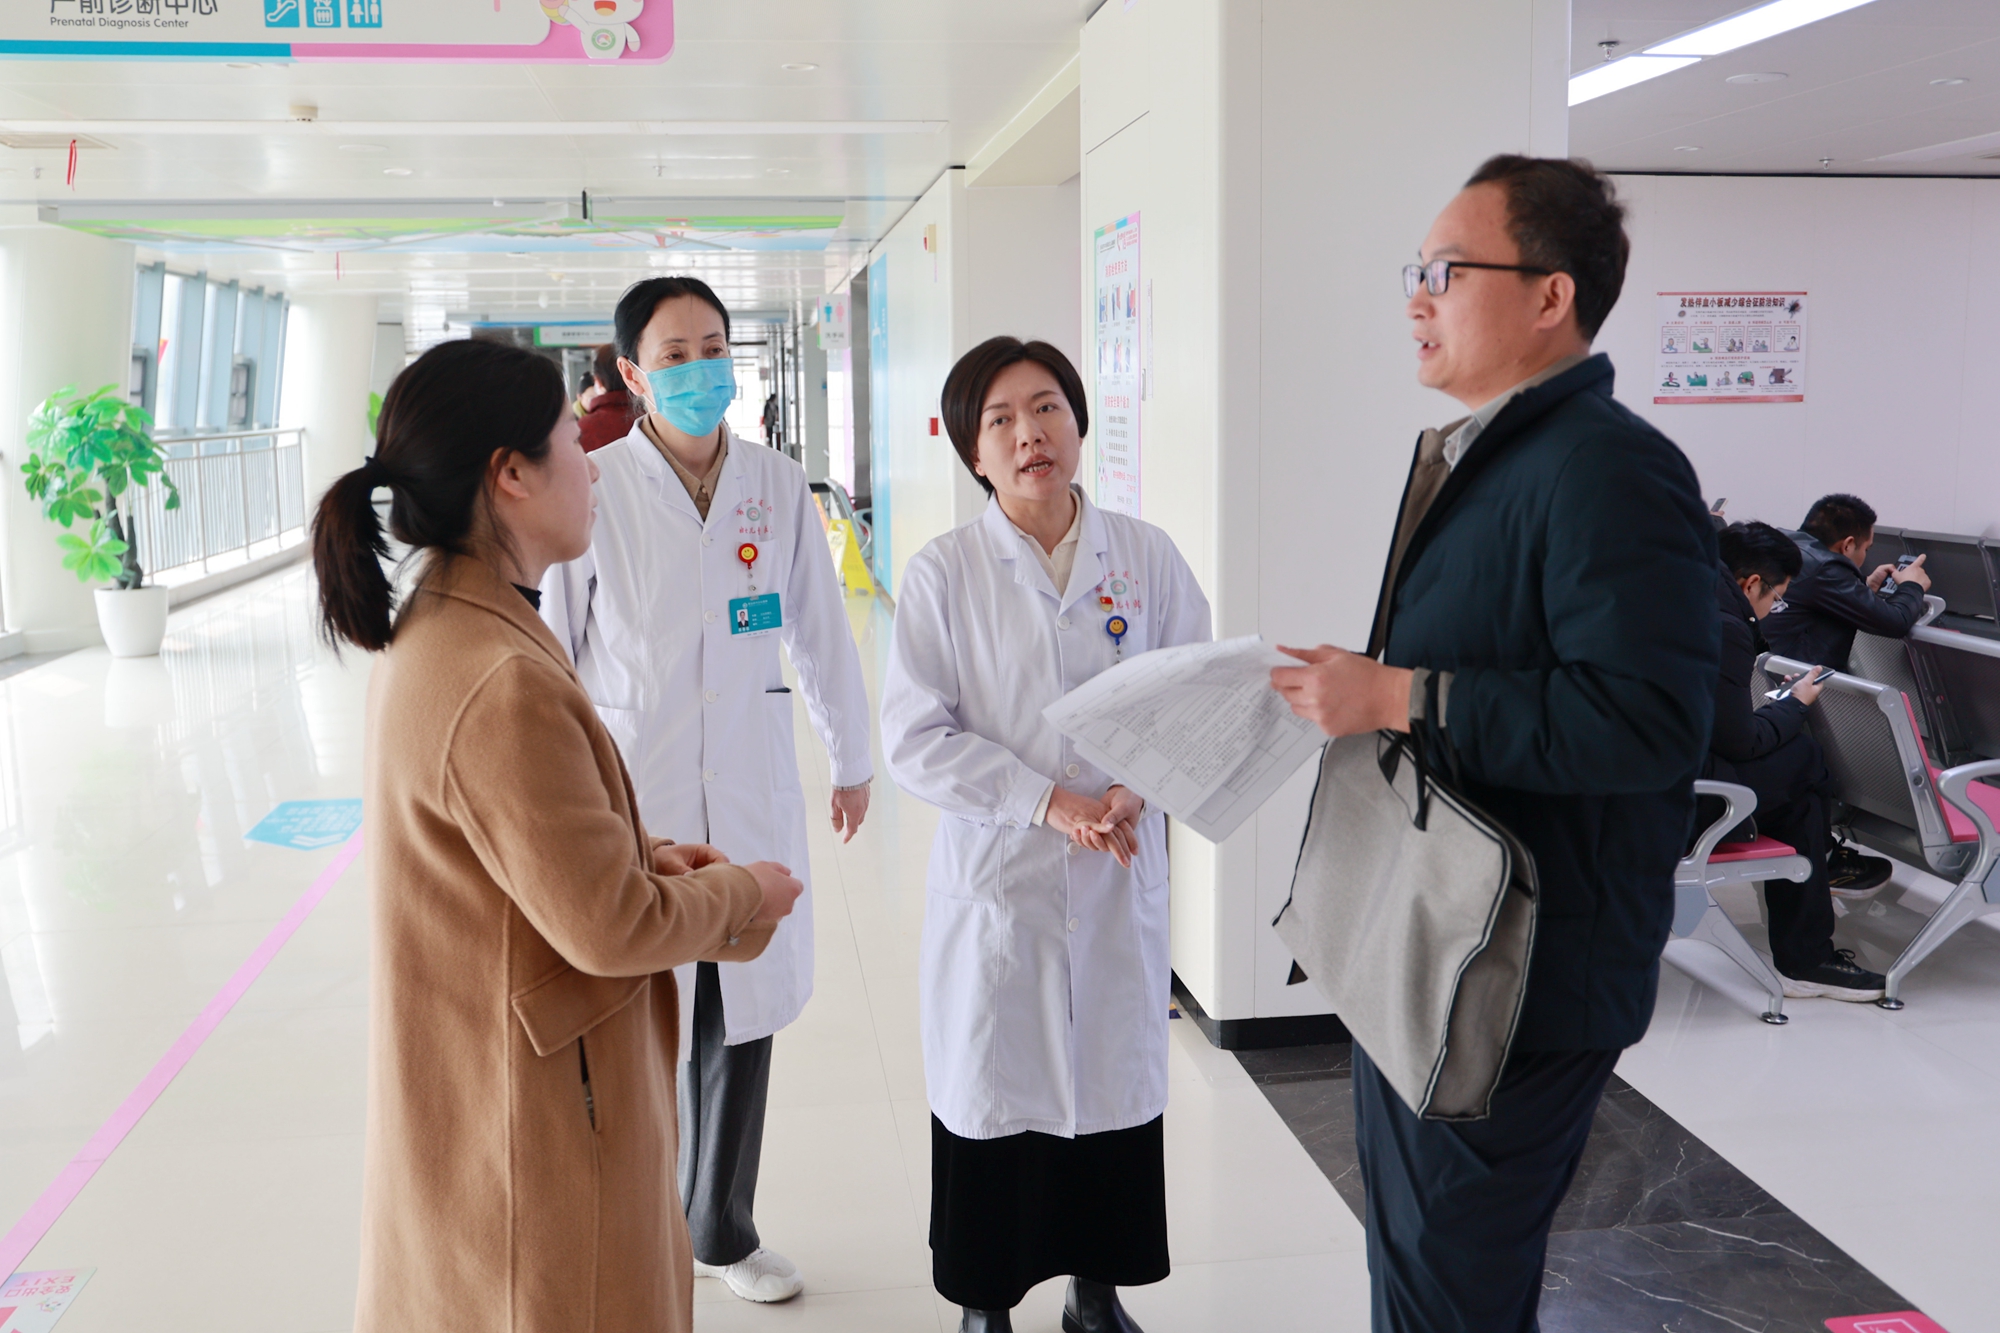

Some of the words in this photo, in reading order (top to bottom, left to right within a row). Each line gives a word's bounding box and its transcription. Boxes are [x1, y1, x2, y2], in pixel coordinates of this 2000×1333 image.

[50, 17, 95, 27] Prenatal
[99, 18, 150, 29] Diagnosis
[154, 18, 189, 28] Center
[1680, 297, 1786, 308] 发热伴血小板减少综合征防治知识
[15, 1275, 76, 1287] EXIT
[4, 1284, 74, 1298] 安全出口
